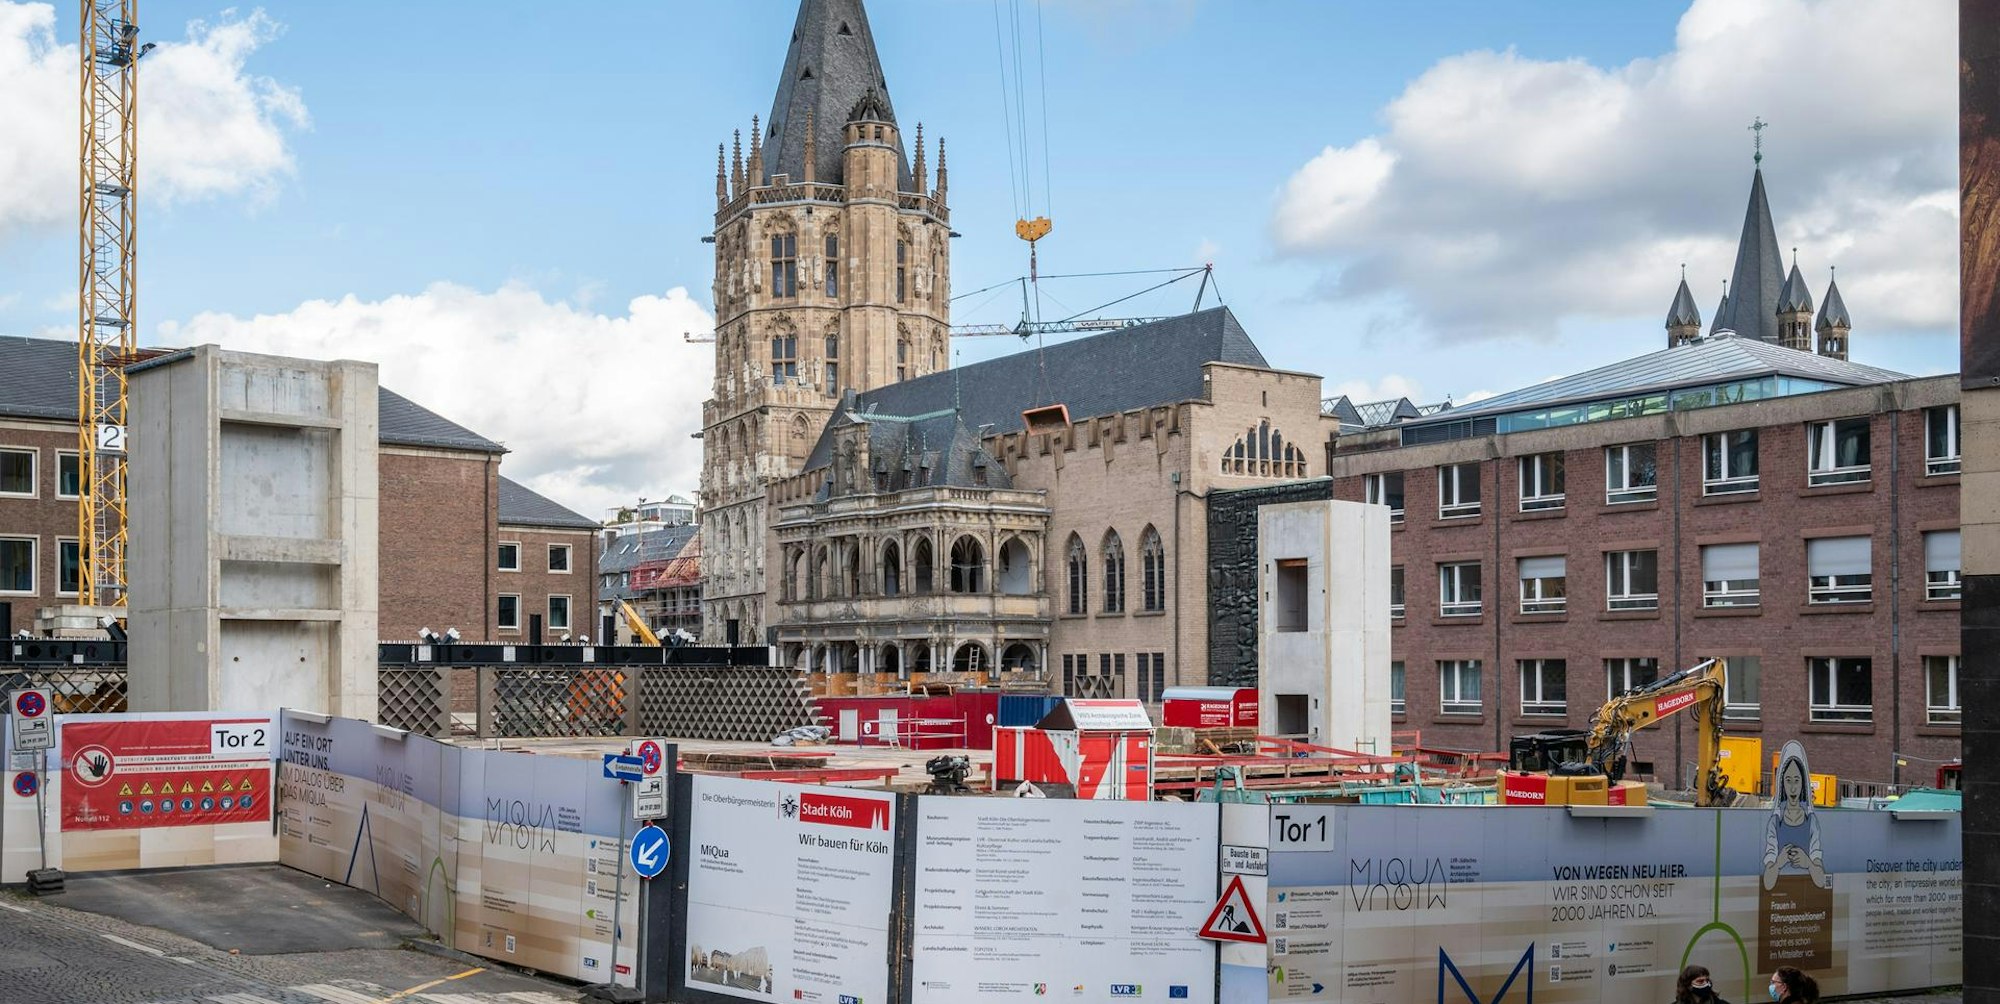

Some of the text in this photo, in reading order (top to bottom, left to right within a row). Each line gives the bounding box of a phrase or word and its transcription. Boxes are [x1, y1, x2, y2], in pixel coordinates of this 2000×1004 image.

[104, 426, 120, 448] 2
[1658, 692, 1694, 711] HAGEDORN
[216, 730, 249, 748] Tor
[252, 729, 266, 746] 2
[284, 731, 332, 752] AUF EIN ORT
[284, 748, 330, 772] UNTER UNS.
[294, 768, 322, 788] DIALOG
[324, 772, 345, 793] ÜBER
[284, 784, 328, 808] DAS MIQUA.
[702, 793, 776, 808] Die Oberbürgermeisterin
[802, 802, 852, 819] Stadt Köln
[1276, 815, 1326, 842] Tor 1
[700, 844, 729, 859] MiQua
[799, 834, 888, 854] Wir bauen für Köln
[1235, 860, 1244, 868] und
[1553, 864, 1688, 880] VON WEGEN NEU HIER.
[1866, 859, 1903, 873] Discover
[1906, 859, 1920, 872] the
[1922, 859, 1937, 875] city
[1552, 883, 1675, 900] WIR SIND SCHON SEIT
[1866, 880, 1877, 889] the
[1894, 880, 1903, 888] an
[1904, 878, 1937, 890] impressive
[1938, 877, 1955, 887] world
[1771, 900, 1796, 910] Frauen in
[1866, 894, 1884, 904] which
[1885, 894, 1894, 903] for
[1913, 894, 1926, 903] than
[1928, 892, 1946, 902] 2000
[1552, 903, 1657, 922] 2000 JAHREN DA.
[1770, 911, 1826, 924] Führungspositionen?
[1112, 985, 1130, 994] LVR
[840, 996, 854, 1004] LVR
